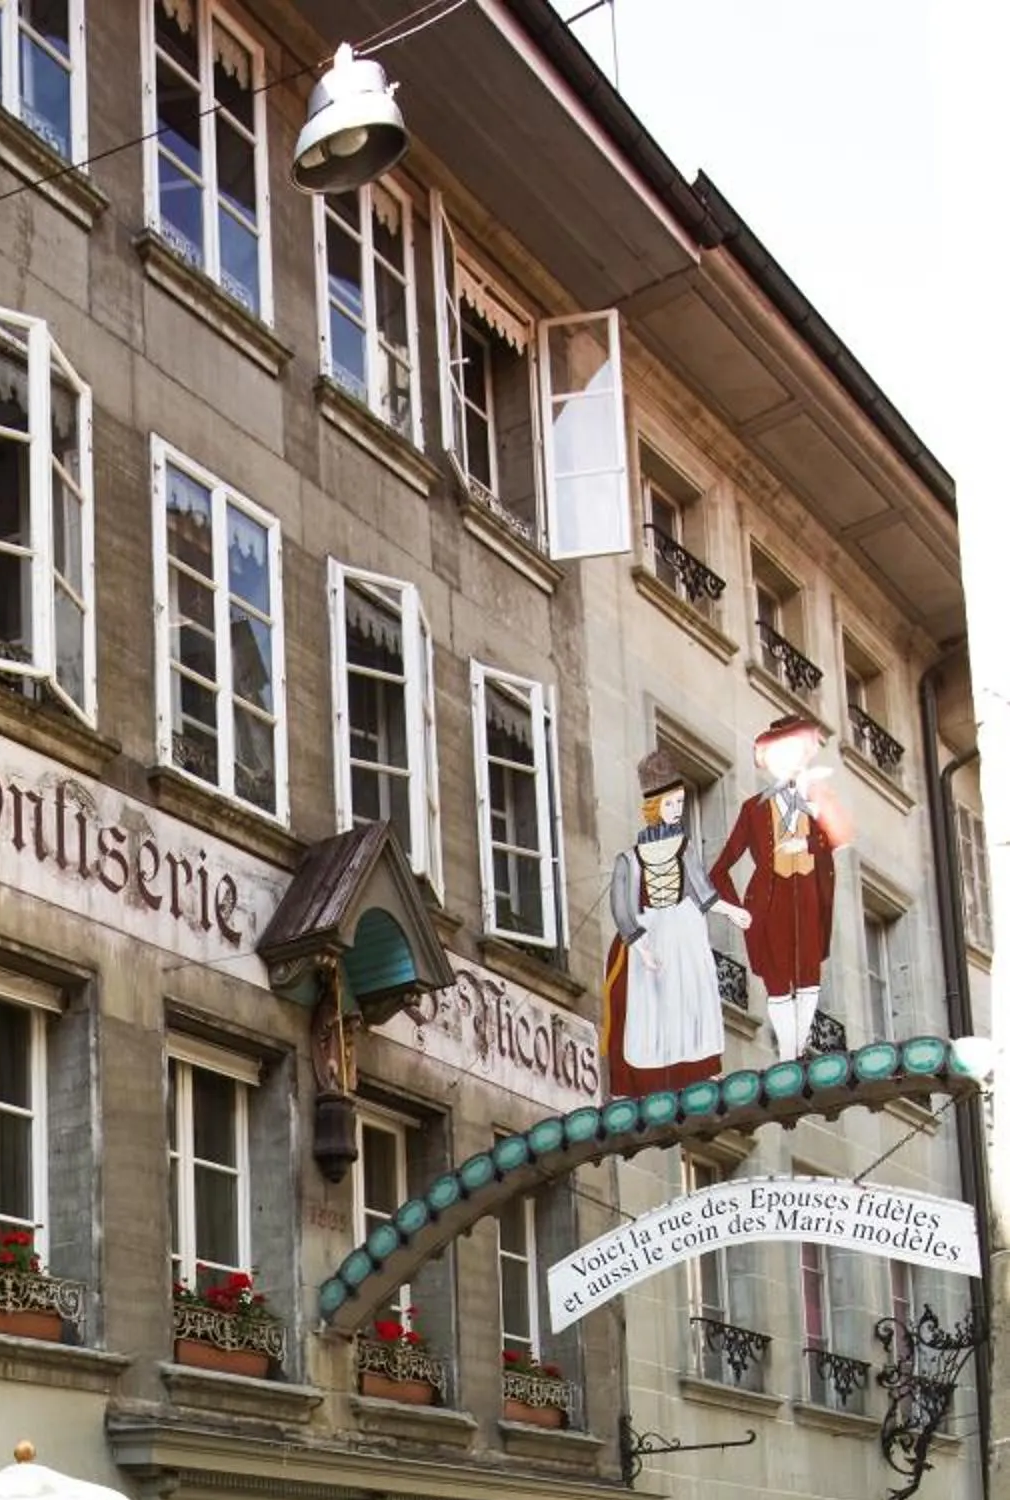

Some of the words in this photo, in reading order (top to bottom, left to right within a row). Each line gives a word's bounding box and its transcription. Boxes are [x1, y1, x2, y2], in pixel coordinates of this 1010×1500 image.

[455, 968, 600, 1096] Nicolas
[563, 1290, 584, 1313] et
[587, 1253, 639, 1297] aussi
[642, 1245, 664, 1265] le
[671, 1223, 720, 1252] coin
[728, 1211, 767, 1236] des
[775, 1208, 846, 1236] Maris
[852, 1221, 962, 1262] modèles
[571, 1236, 626, 1278] Voici
[629, 1229, 652, 1249] la
[658, 1210, 693, 1236] rue
[701, 1199, 740, 1220] des
[750, 1186, 850, 1213] Epouses
[856, 1193, 941, 1230] fidèles
